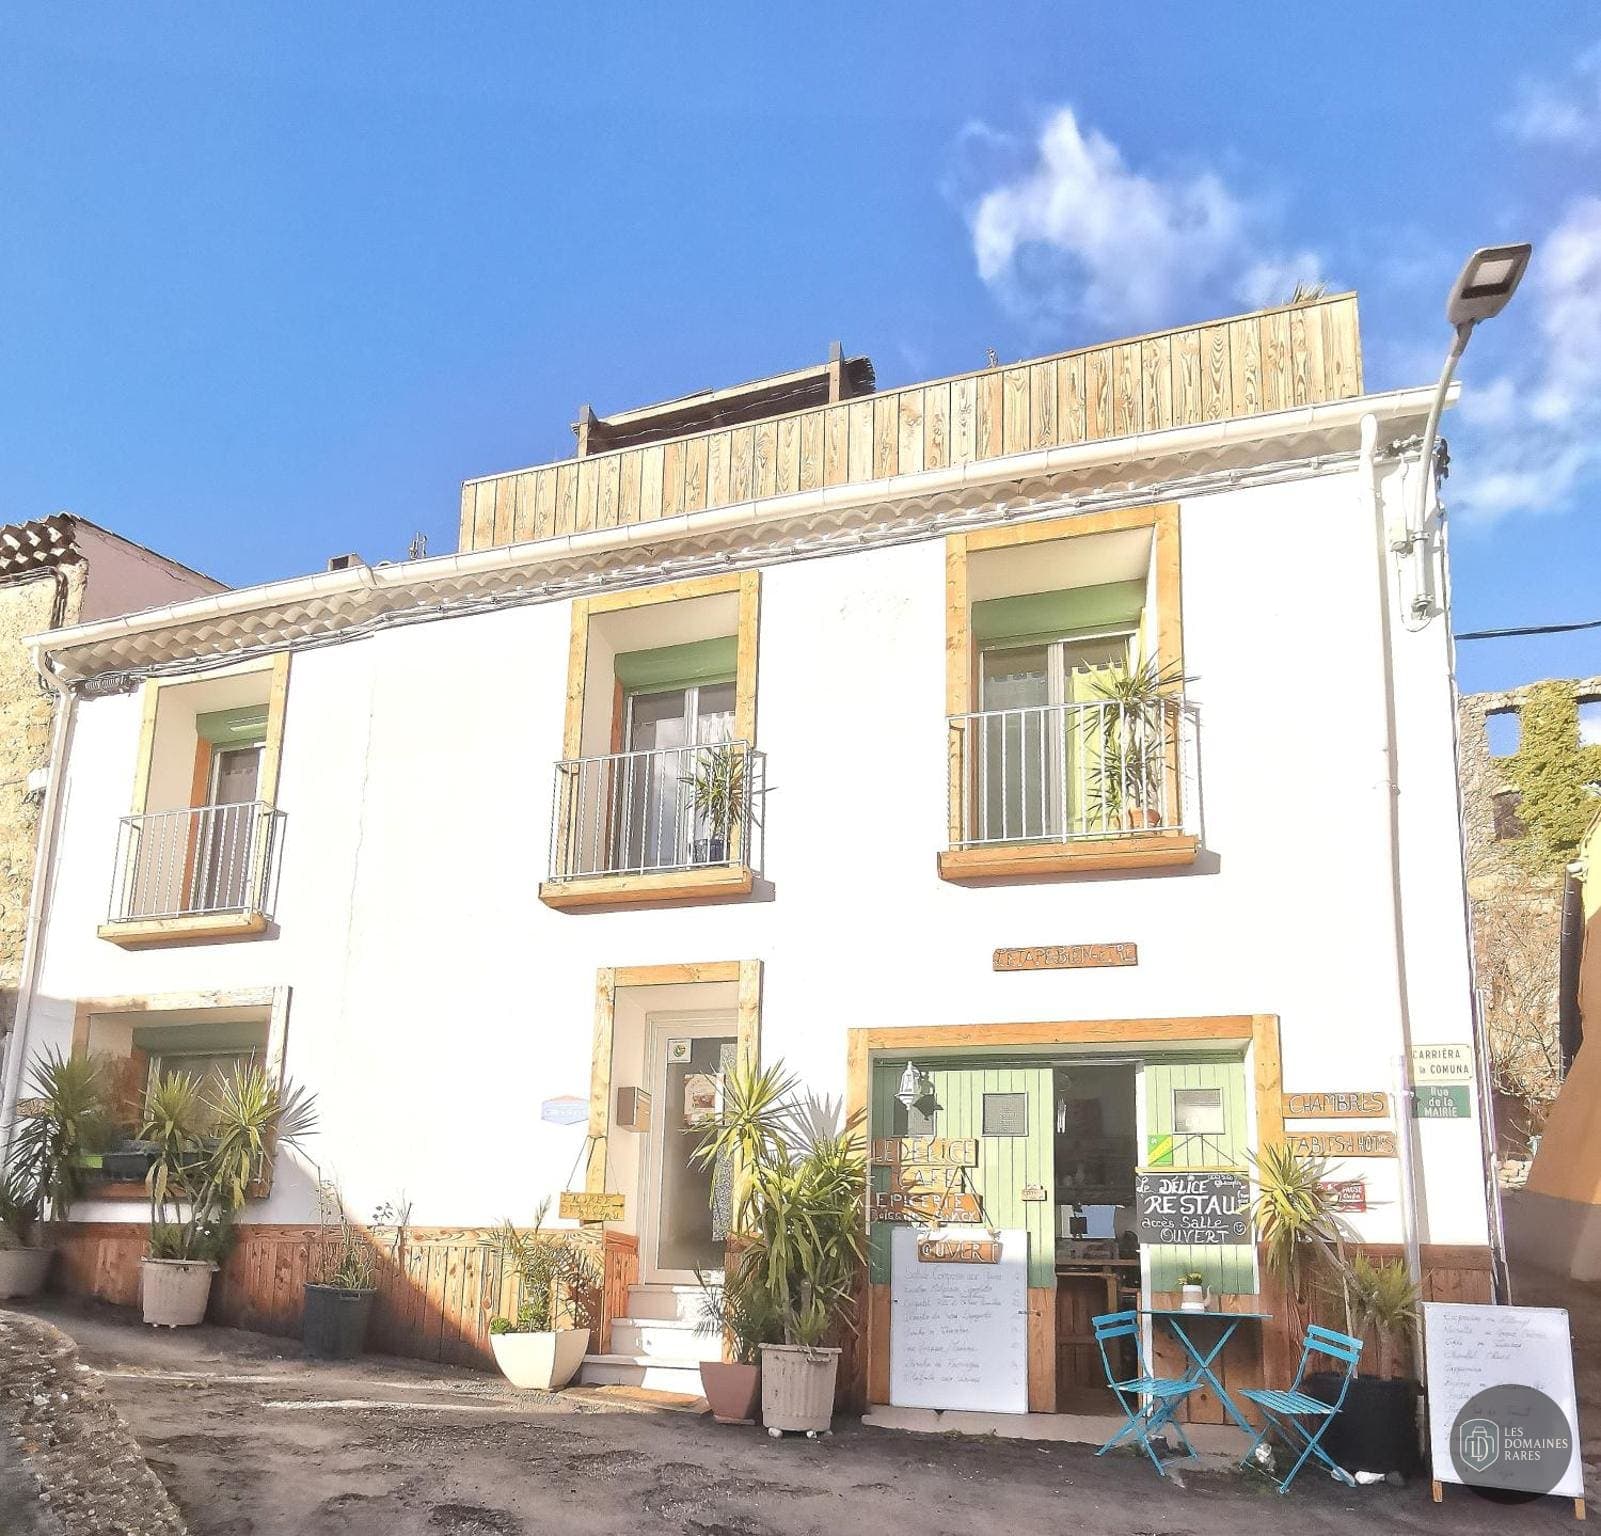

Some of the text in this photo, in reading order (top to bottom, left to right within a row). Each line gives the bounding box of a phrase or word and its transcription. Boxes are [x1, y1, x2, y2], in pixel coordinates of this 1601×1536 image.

[1430, 1064, 1470, 1074] COMUNA
[1430, 1086, 1449, 1097] Rue
[1288, 1092, 1384, 1114] CHAMBRES
[1428, 1097, 1454, 1107] de la
[1423, 1106, 1458, 1117] MAIRIE
[1159, 1175, 1209, 1194] DÉLICE
[1141, 1216, 1175, 1229] accès
[1160, 1228, 1231, 1244] OUVERT
[922, 1243, 999, 1262] OUVERT
